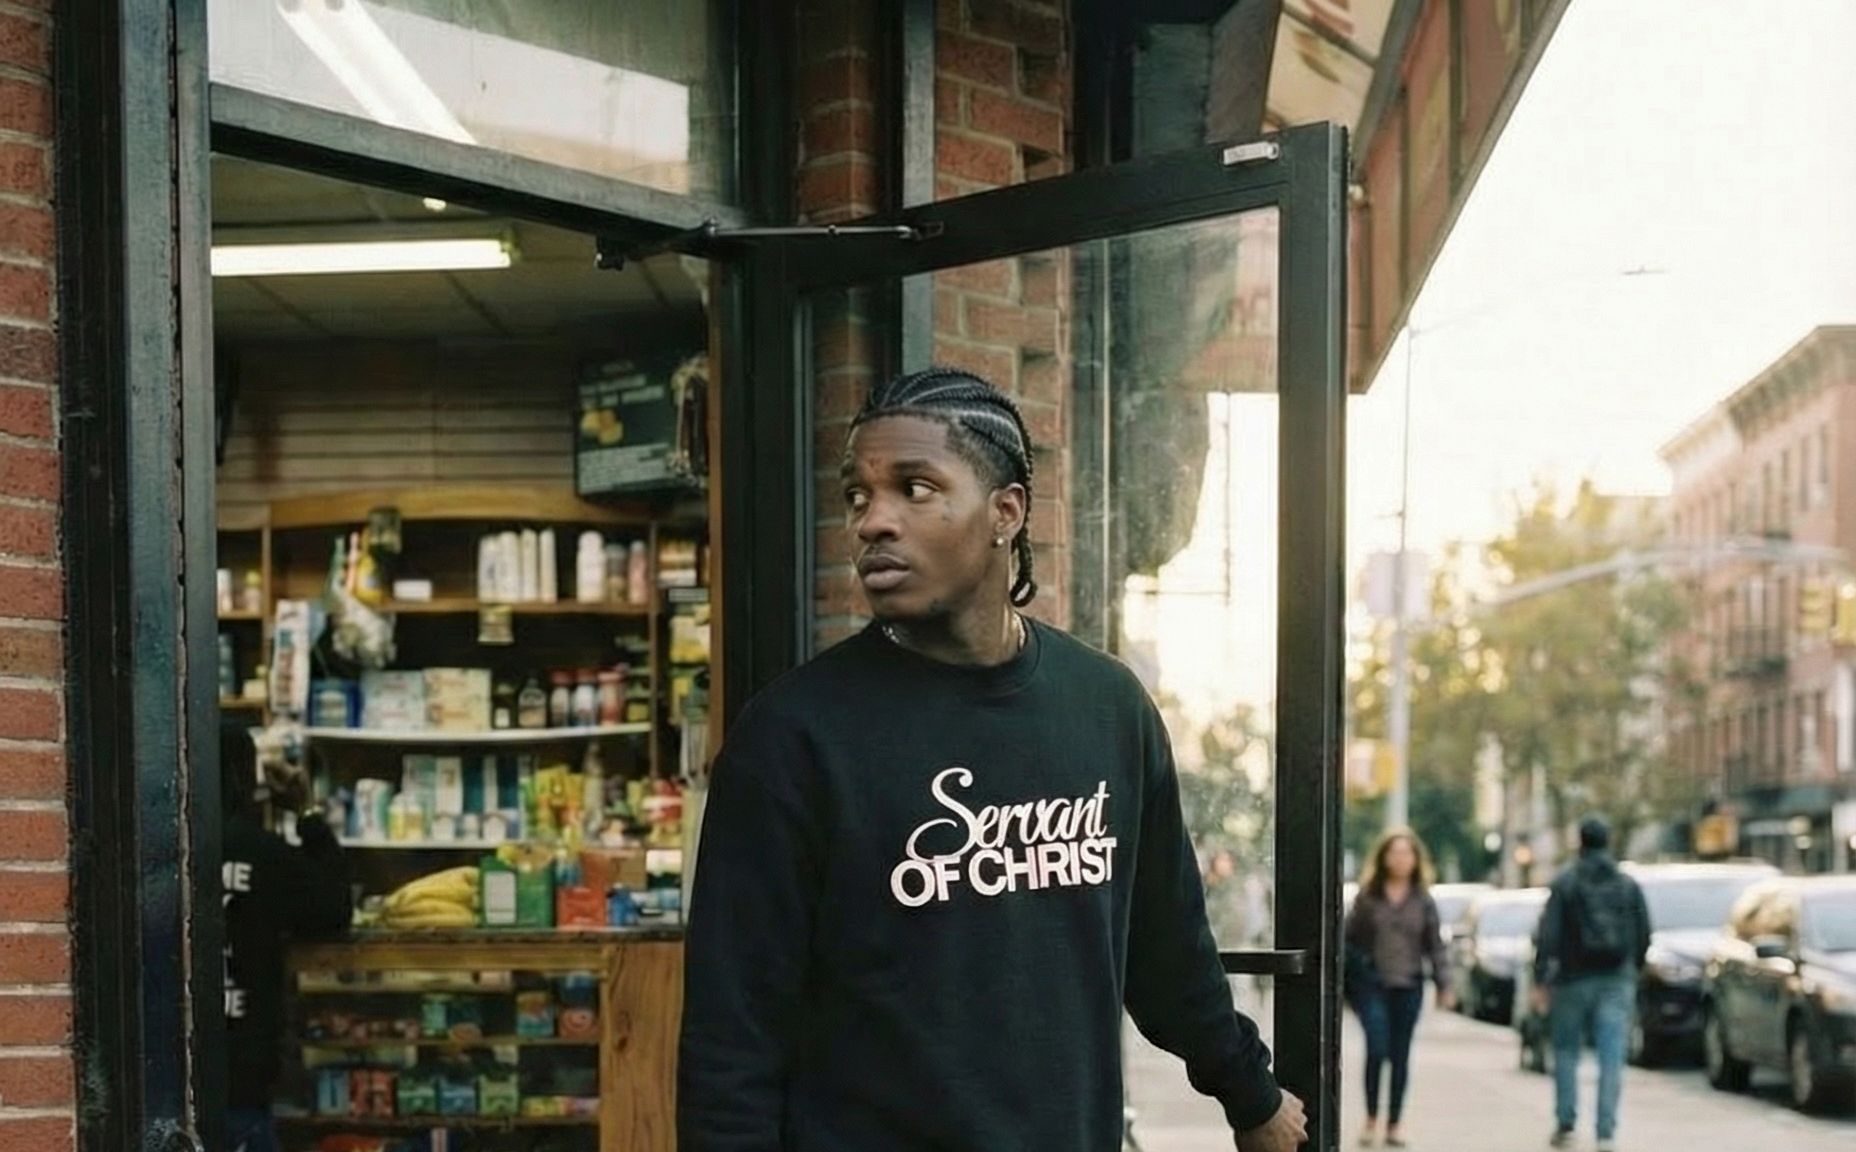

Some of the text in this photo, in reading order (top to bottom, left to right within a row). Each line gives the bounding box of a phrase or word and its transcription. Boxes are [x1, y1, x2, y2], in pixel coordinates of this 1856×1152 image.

[906, 767, 1110, 864] Servant
[890, 837, 1117, 907] OF CHRIST
